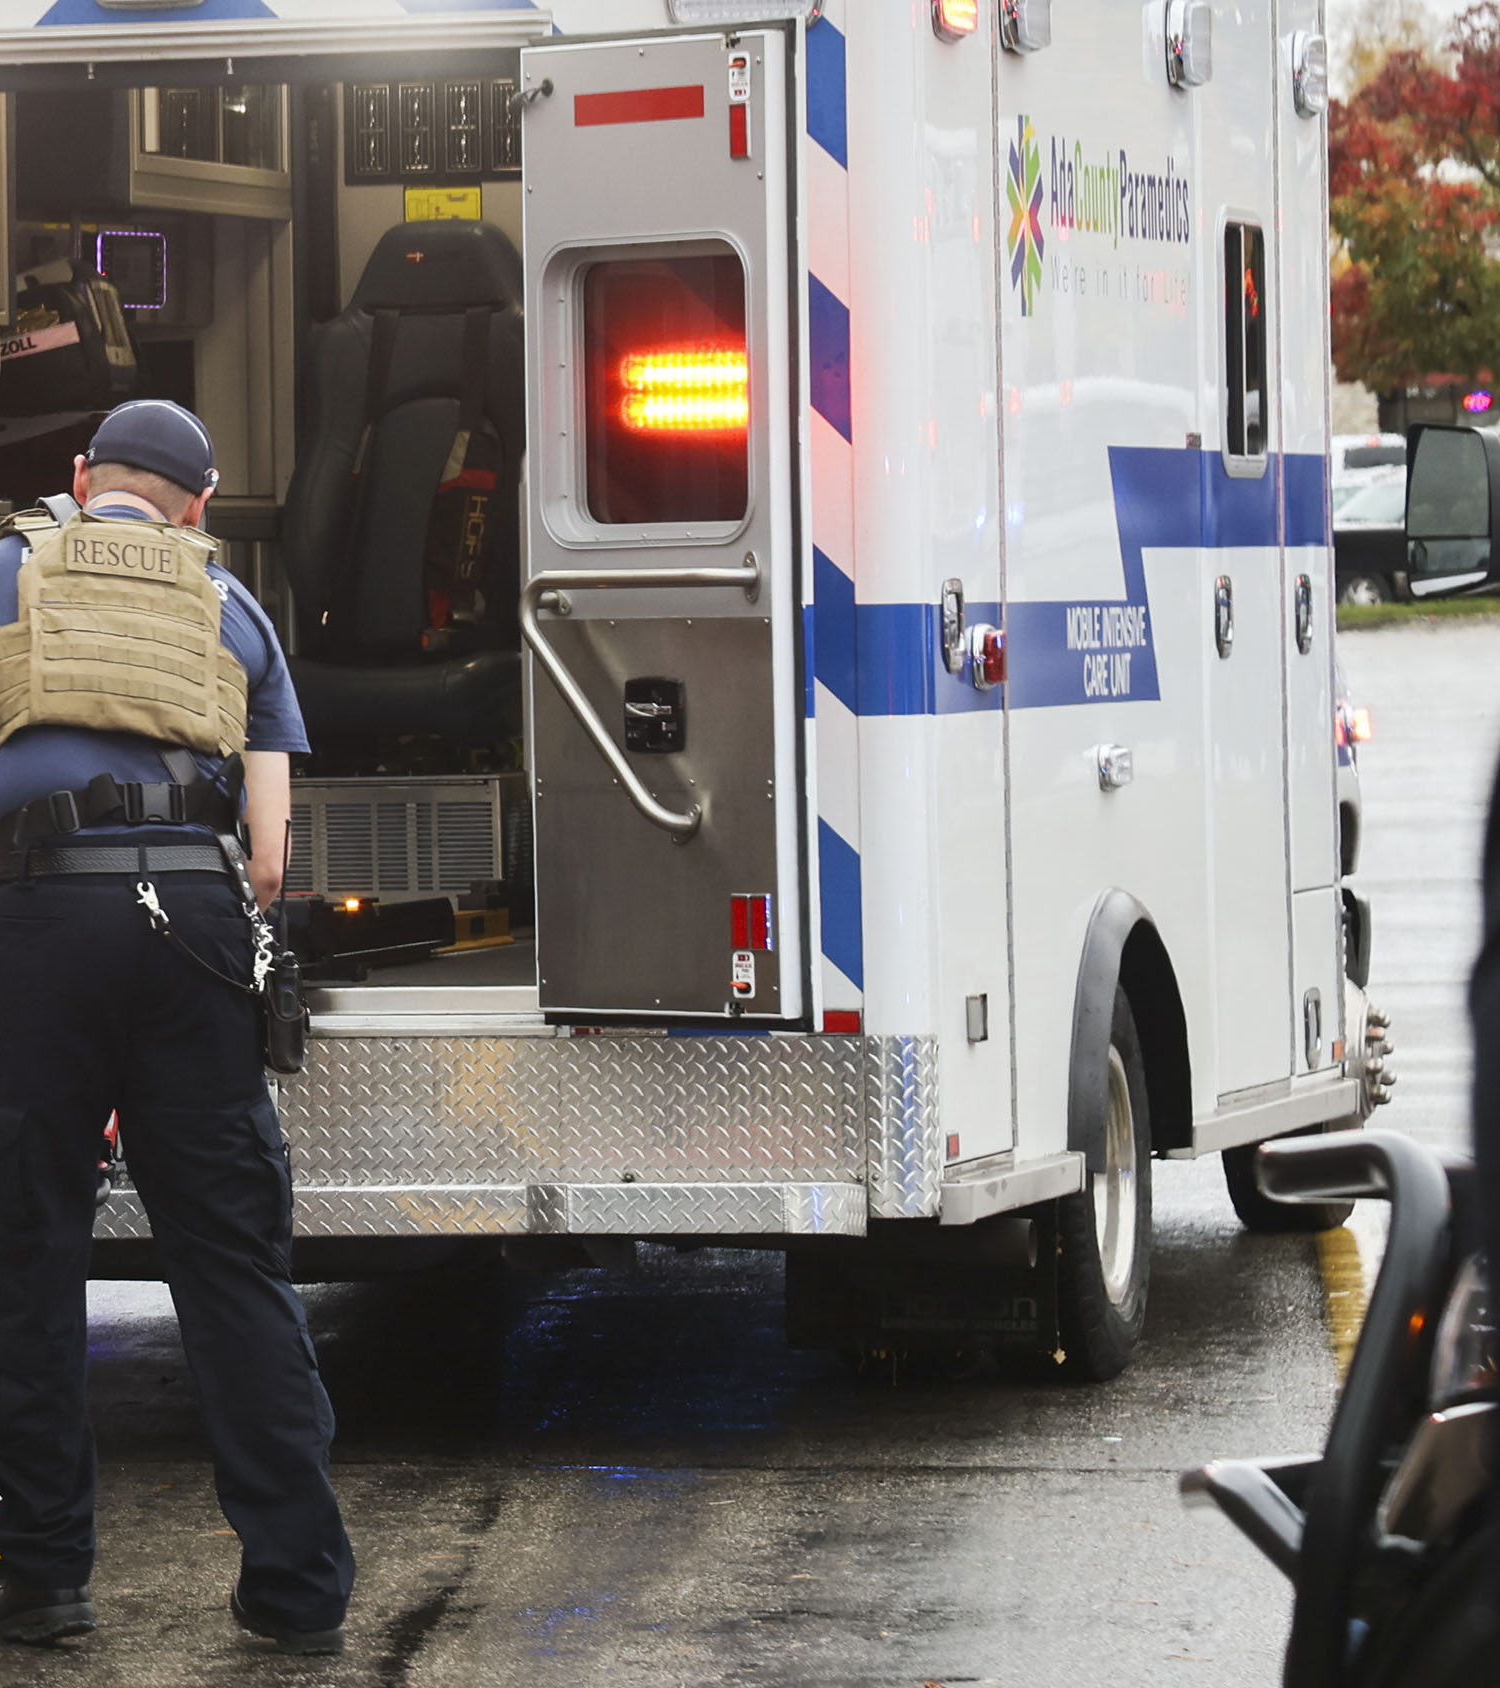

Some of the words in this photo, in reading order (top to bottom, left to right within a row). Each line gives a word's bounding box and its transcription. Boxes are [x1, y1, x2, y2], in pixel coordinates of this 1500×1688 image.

[1050, 254, 1085, 295] We're
[1096, 260, 1109, 297] in
[0, 336, 37, 357] ZOLL
[72, 538, 174, 575] RESCUE
[1066, 606, 1101, 650] MOBILE
[1102, 605, 1147, 648] INTENSIVE
[1083, 653, 1109, 697] CARE
[1110, 652, 1132, 697] UNIT
